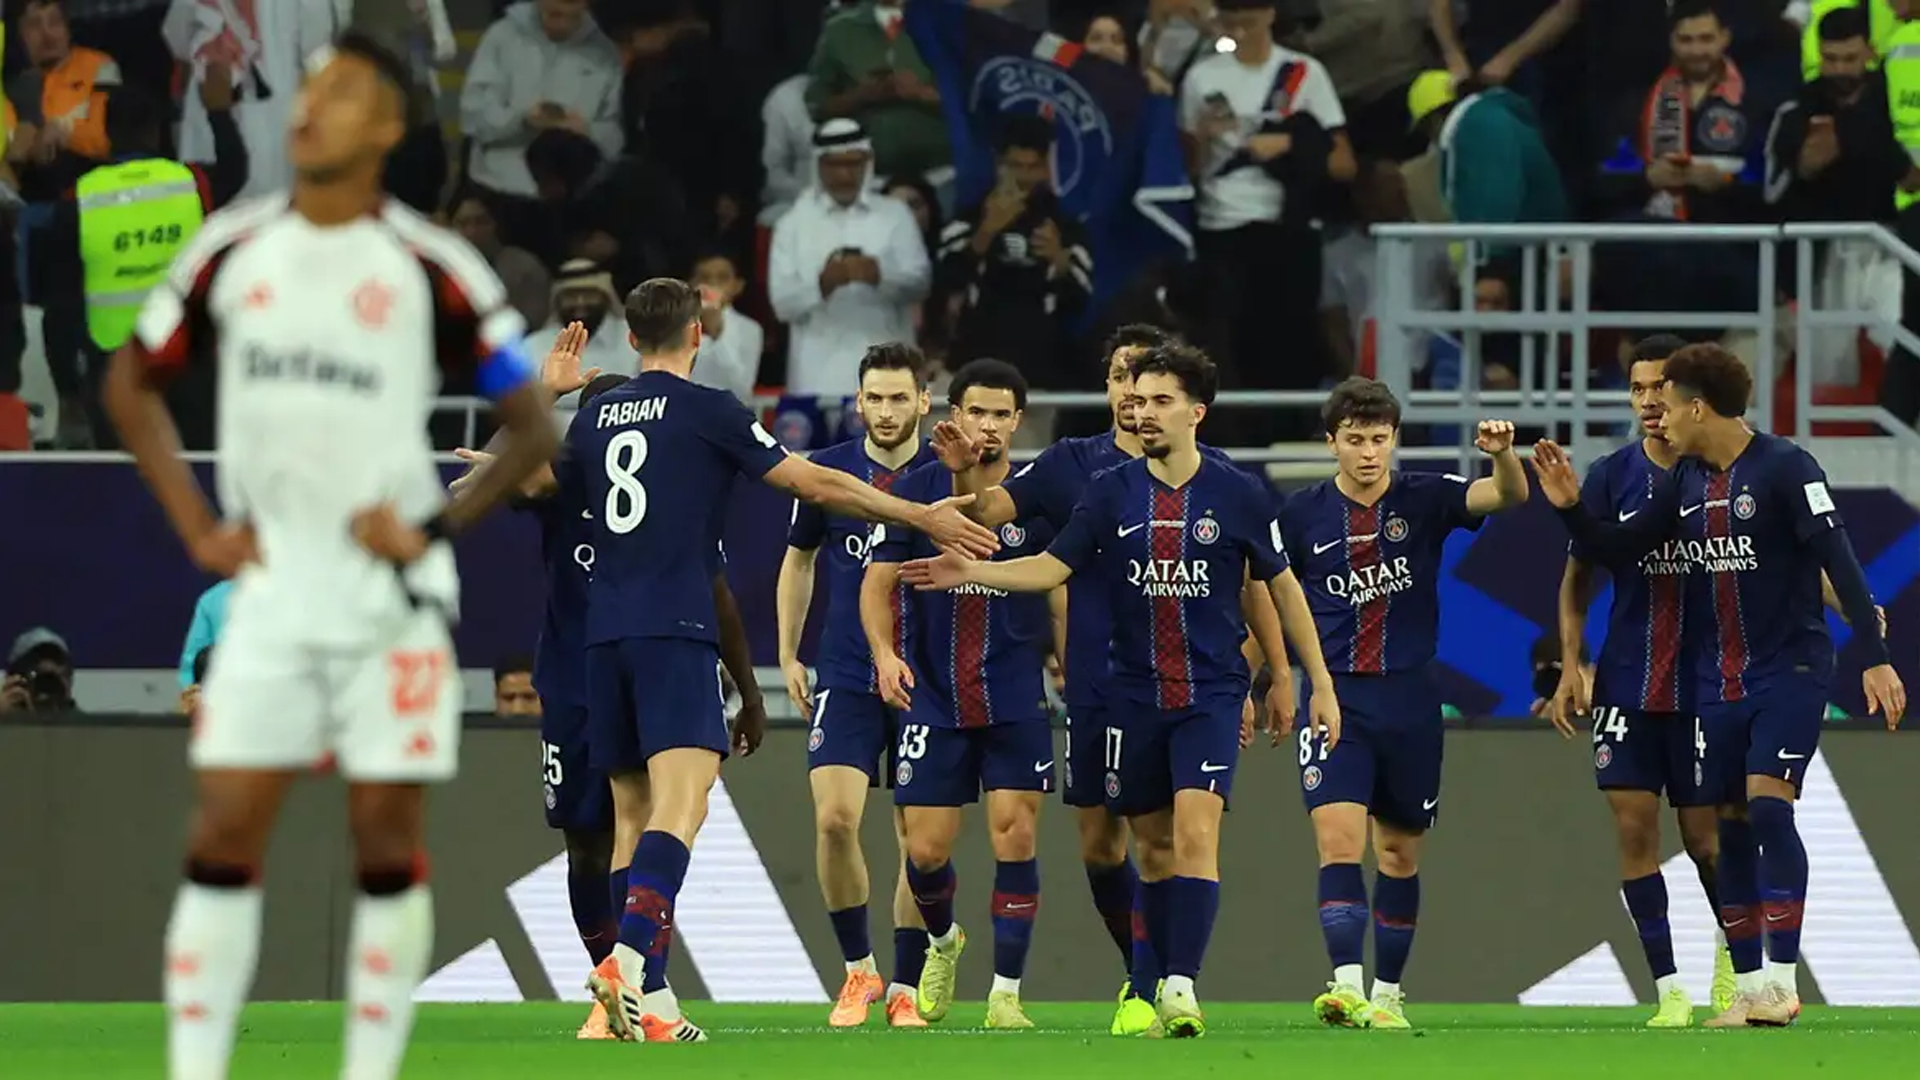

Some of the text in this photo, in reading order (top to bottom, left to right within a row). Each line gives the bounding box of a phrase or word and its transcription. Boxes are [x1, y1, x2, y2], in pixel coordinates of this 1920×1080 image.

[597, 396, 668, 429] FABIAN
[605, 429, 648, 534] 8
[1687, 535, 1756, 565] QATAR
[1704, 557, 1759, 574] AIRWAYS
[1127, 559, 1210, 586] QATAR
[1326, 556, 1411, 598] QATAR
[1643, 561, 1693, 575] AIRWA
[1142, 583, 1211, 598] AIRWAYS
[1350, 575, 1413, 606] AIRWAYS
[1592, 706, 1629, 742] 24
[1106, 726, 1123, 770] 17
